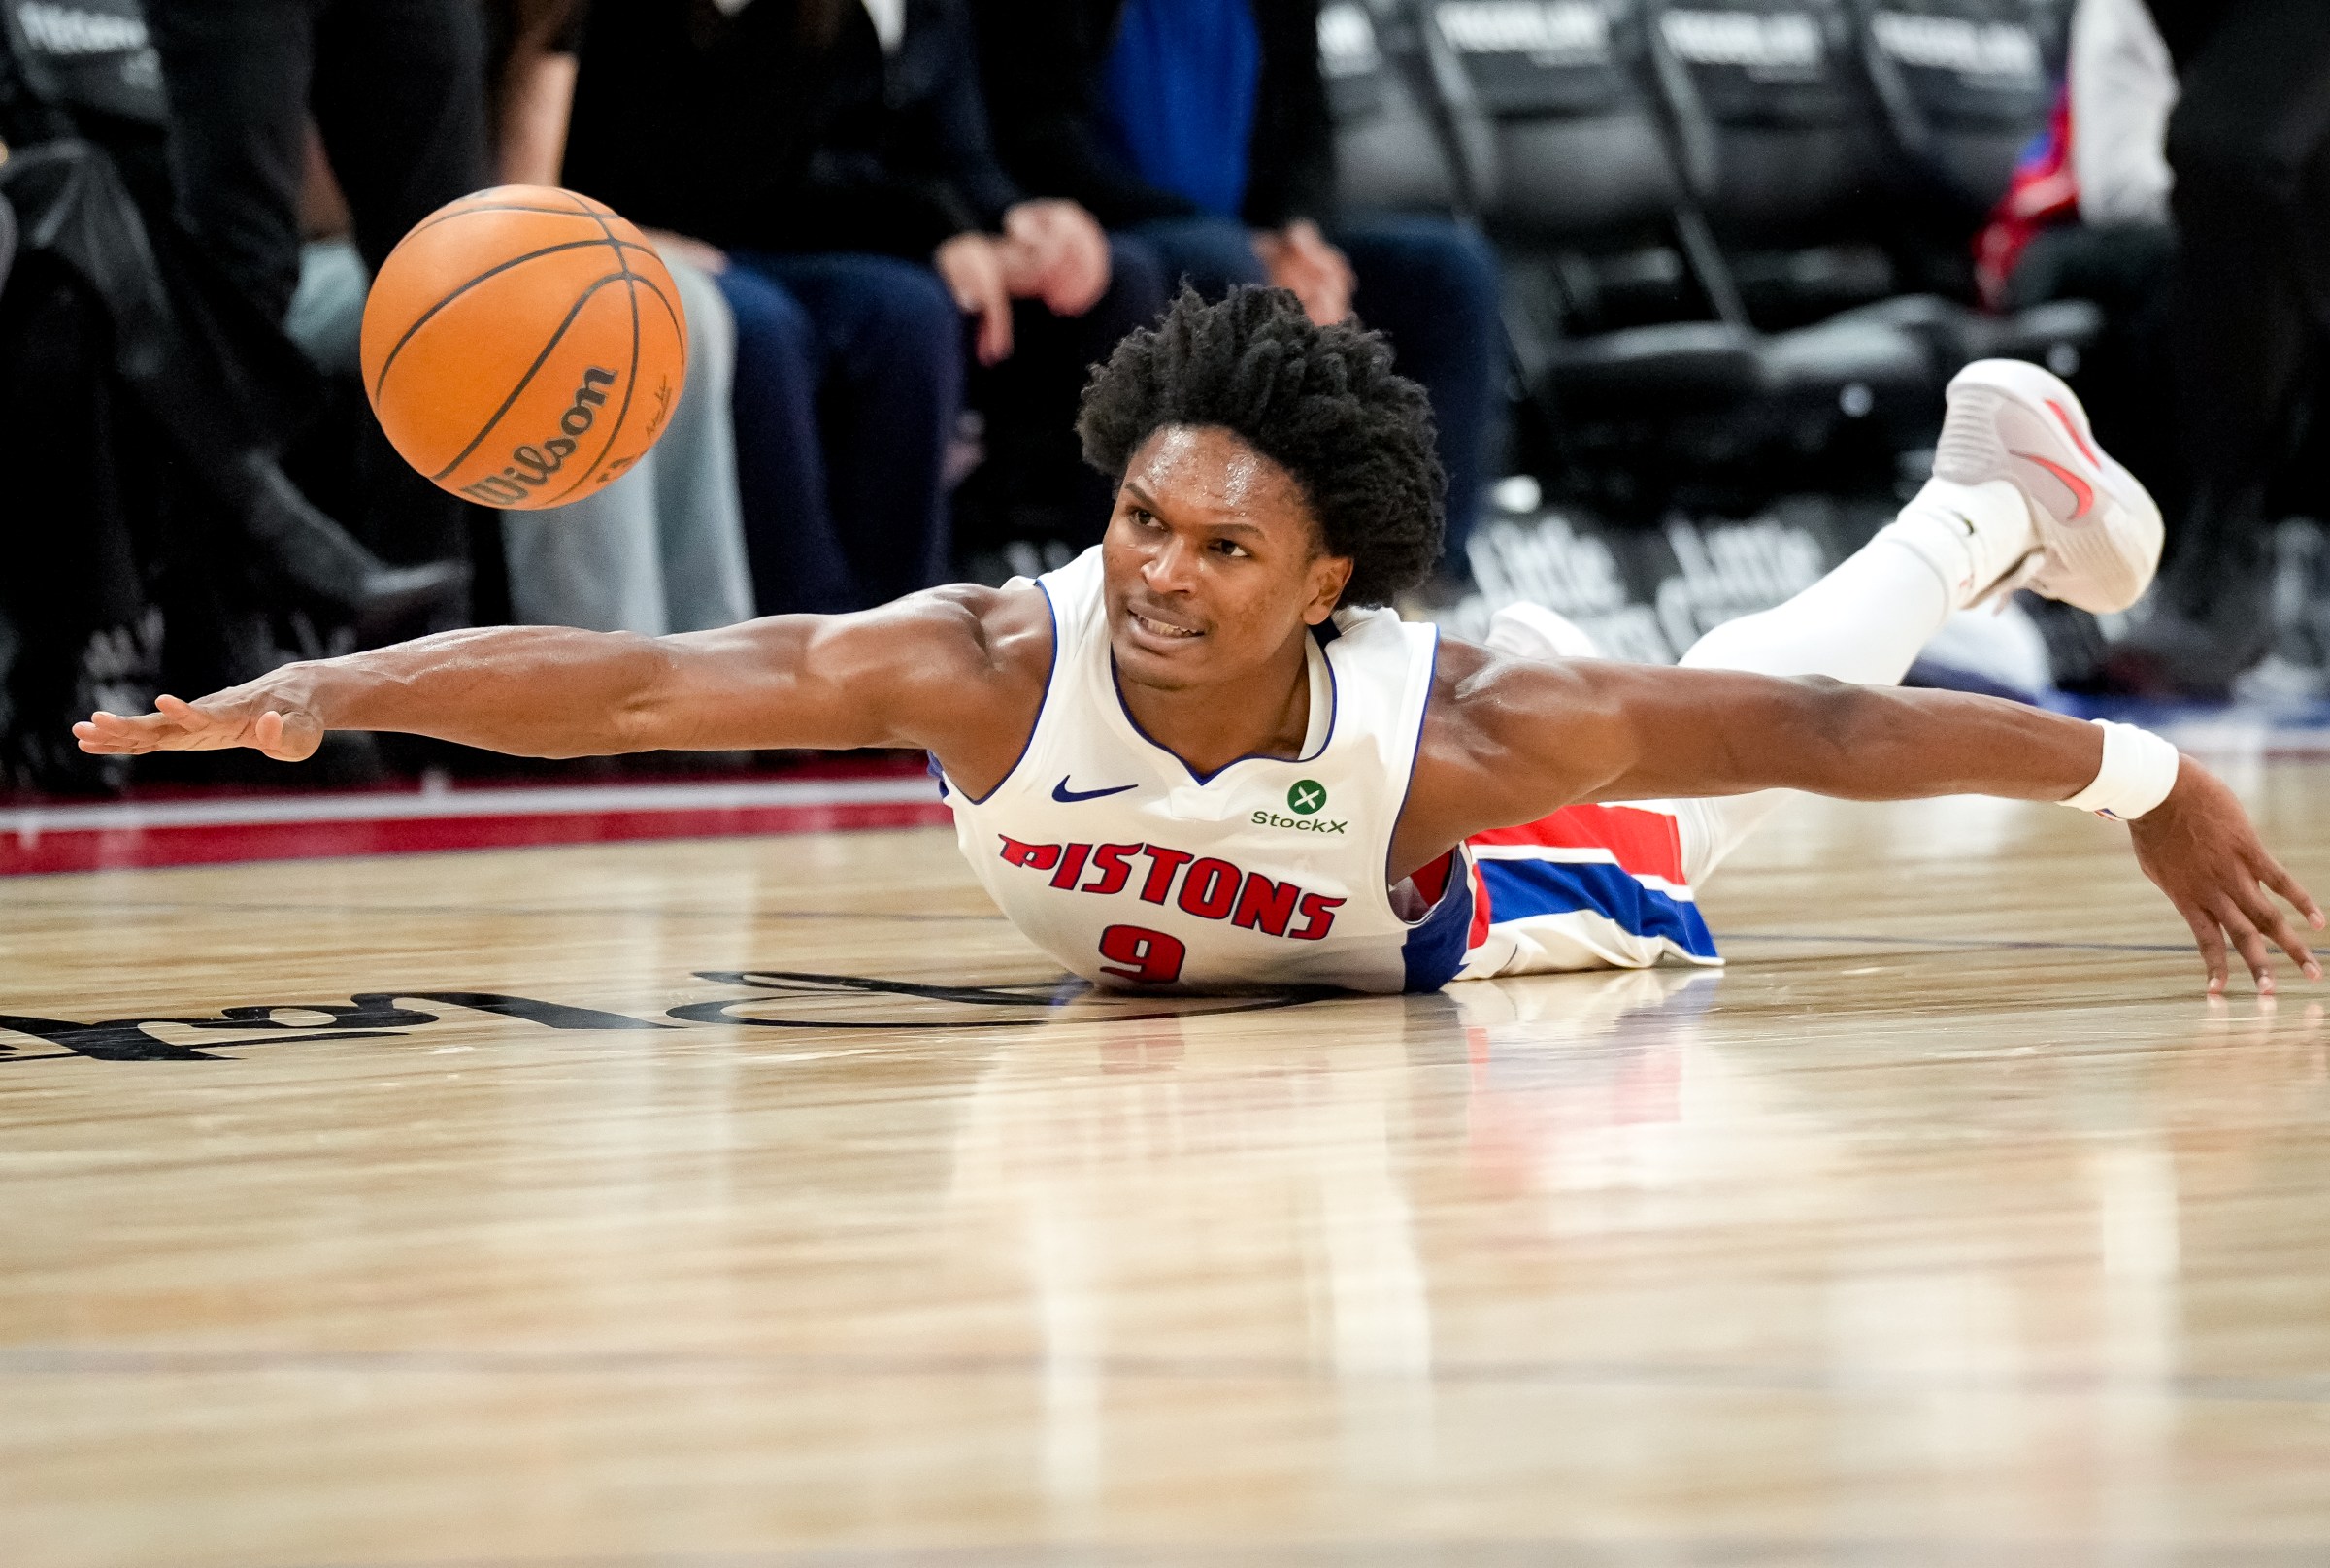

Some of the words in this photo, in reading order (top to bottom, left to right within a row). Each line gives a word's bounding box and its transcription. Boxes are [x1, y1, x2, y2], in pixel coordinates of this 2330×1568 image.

[458, 365, 619, 505] Wilson
[1250, 810, 1348, 835] StockX
[997, 833, 1348, 941] PISTONS
[1098, 924, 1186, 985] 9
